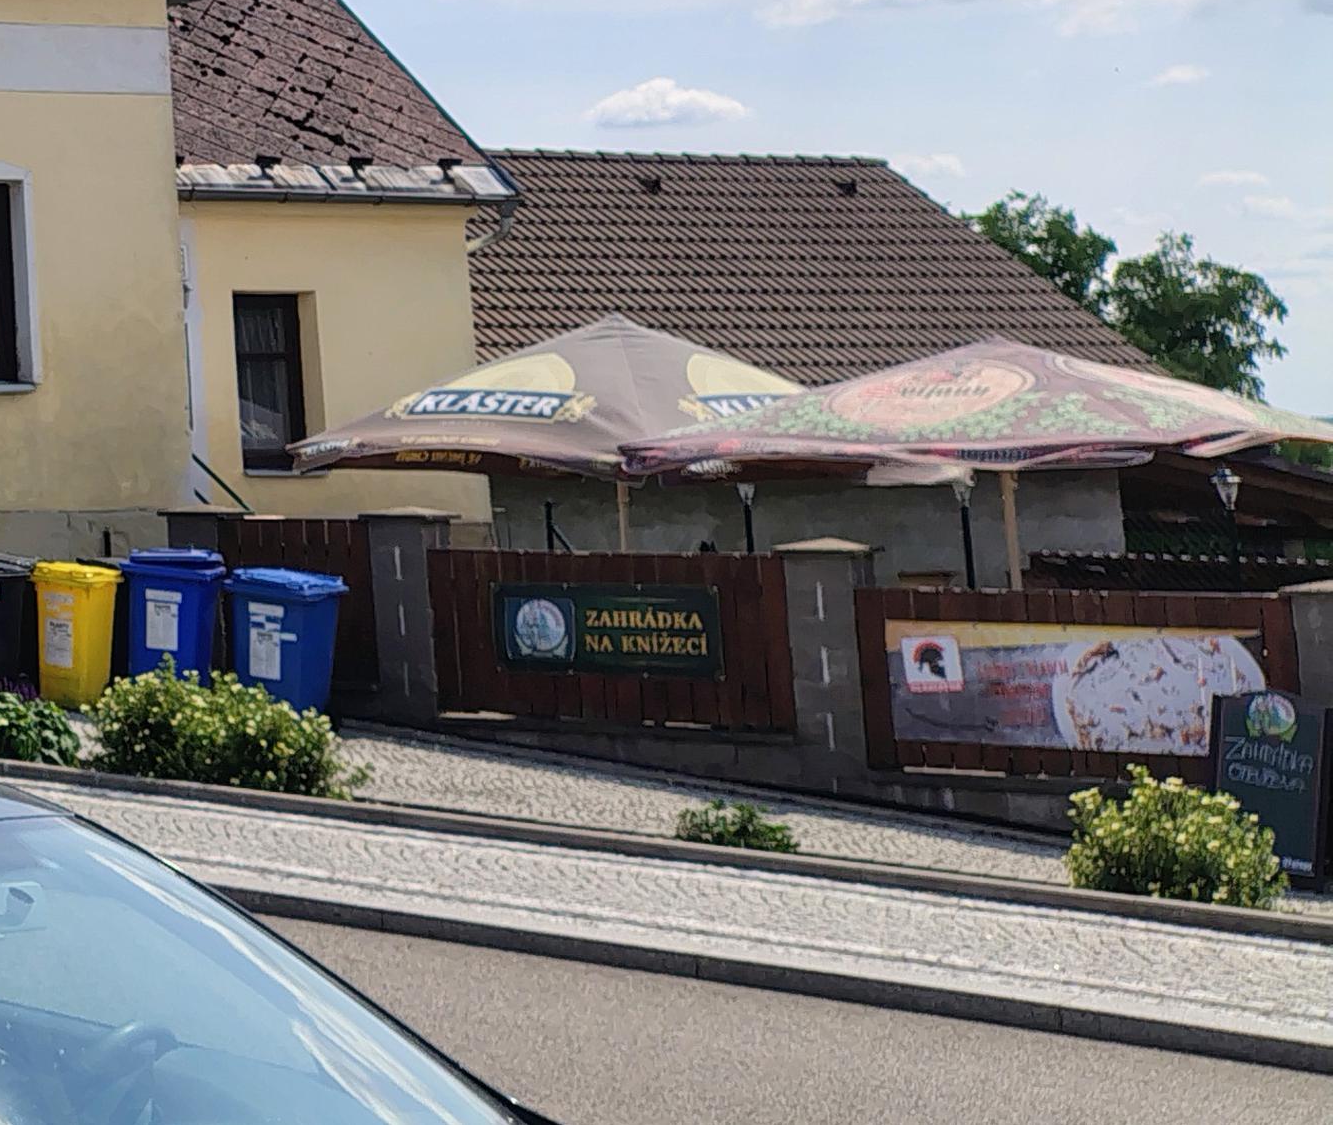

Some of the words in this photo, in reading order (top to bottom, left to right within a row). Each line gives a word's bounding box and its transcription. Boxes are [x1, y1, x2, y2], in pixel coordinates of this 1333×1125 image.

[413, 391, 561, 418] KLÁŠTER
[585, 606, 703, 630] ZAHRÁDKA
[585, 634, 613, 652] NA
[621, 631, 708, 656] KNÍŽECÍ
